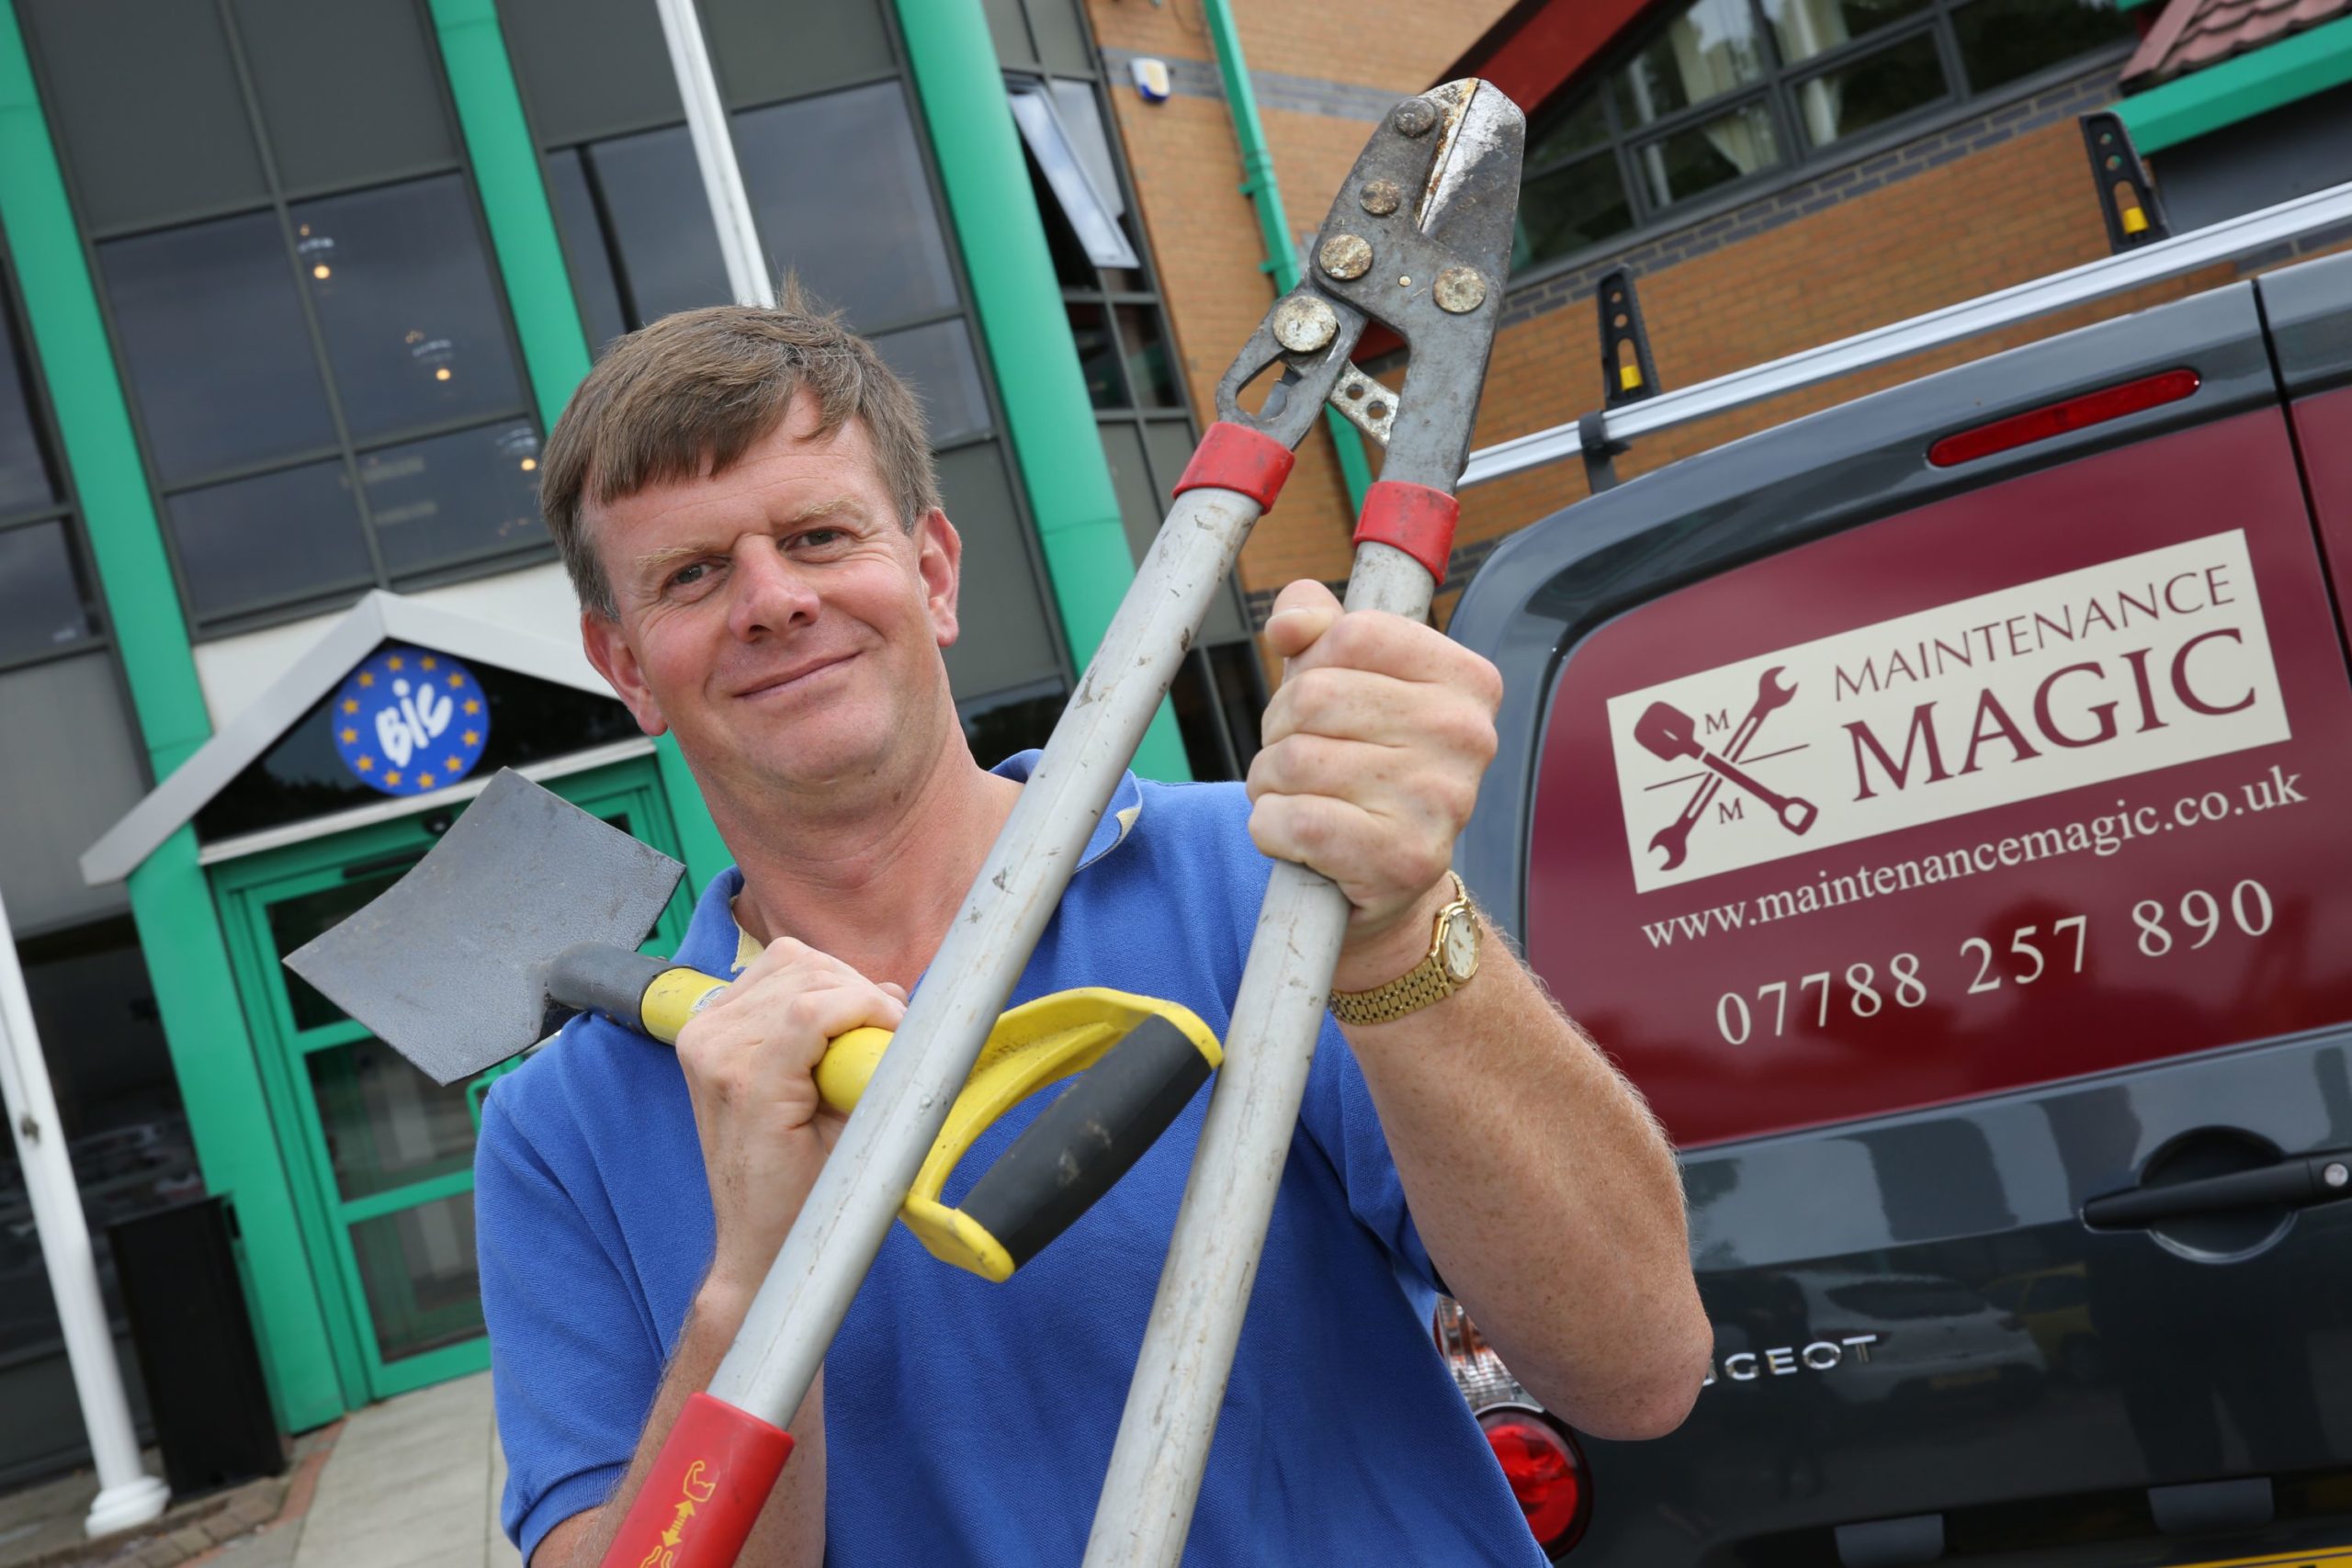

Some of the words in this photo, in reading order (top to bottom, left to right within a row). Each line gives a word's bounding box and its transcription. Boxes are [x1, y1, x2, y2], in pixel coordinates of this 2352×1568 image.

[1835, 564, 2235, 702] MAINTENANCE
[1704, 708, 1730, 735] M
[1841, 627, 2256, 802] MAGIC
[1641, 764, 2308, 949] www.maintenancemagic.co.uk
[1717, 797, 1745, 824] M
[1715, 953, 1928, 1045] 07788
[1960, 915, 2087, 995] 257
[2131, 879, 2274, 957] 890
